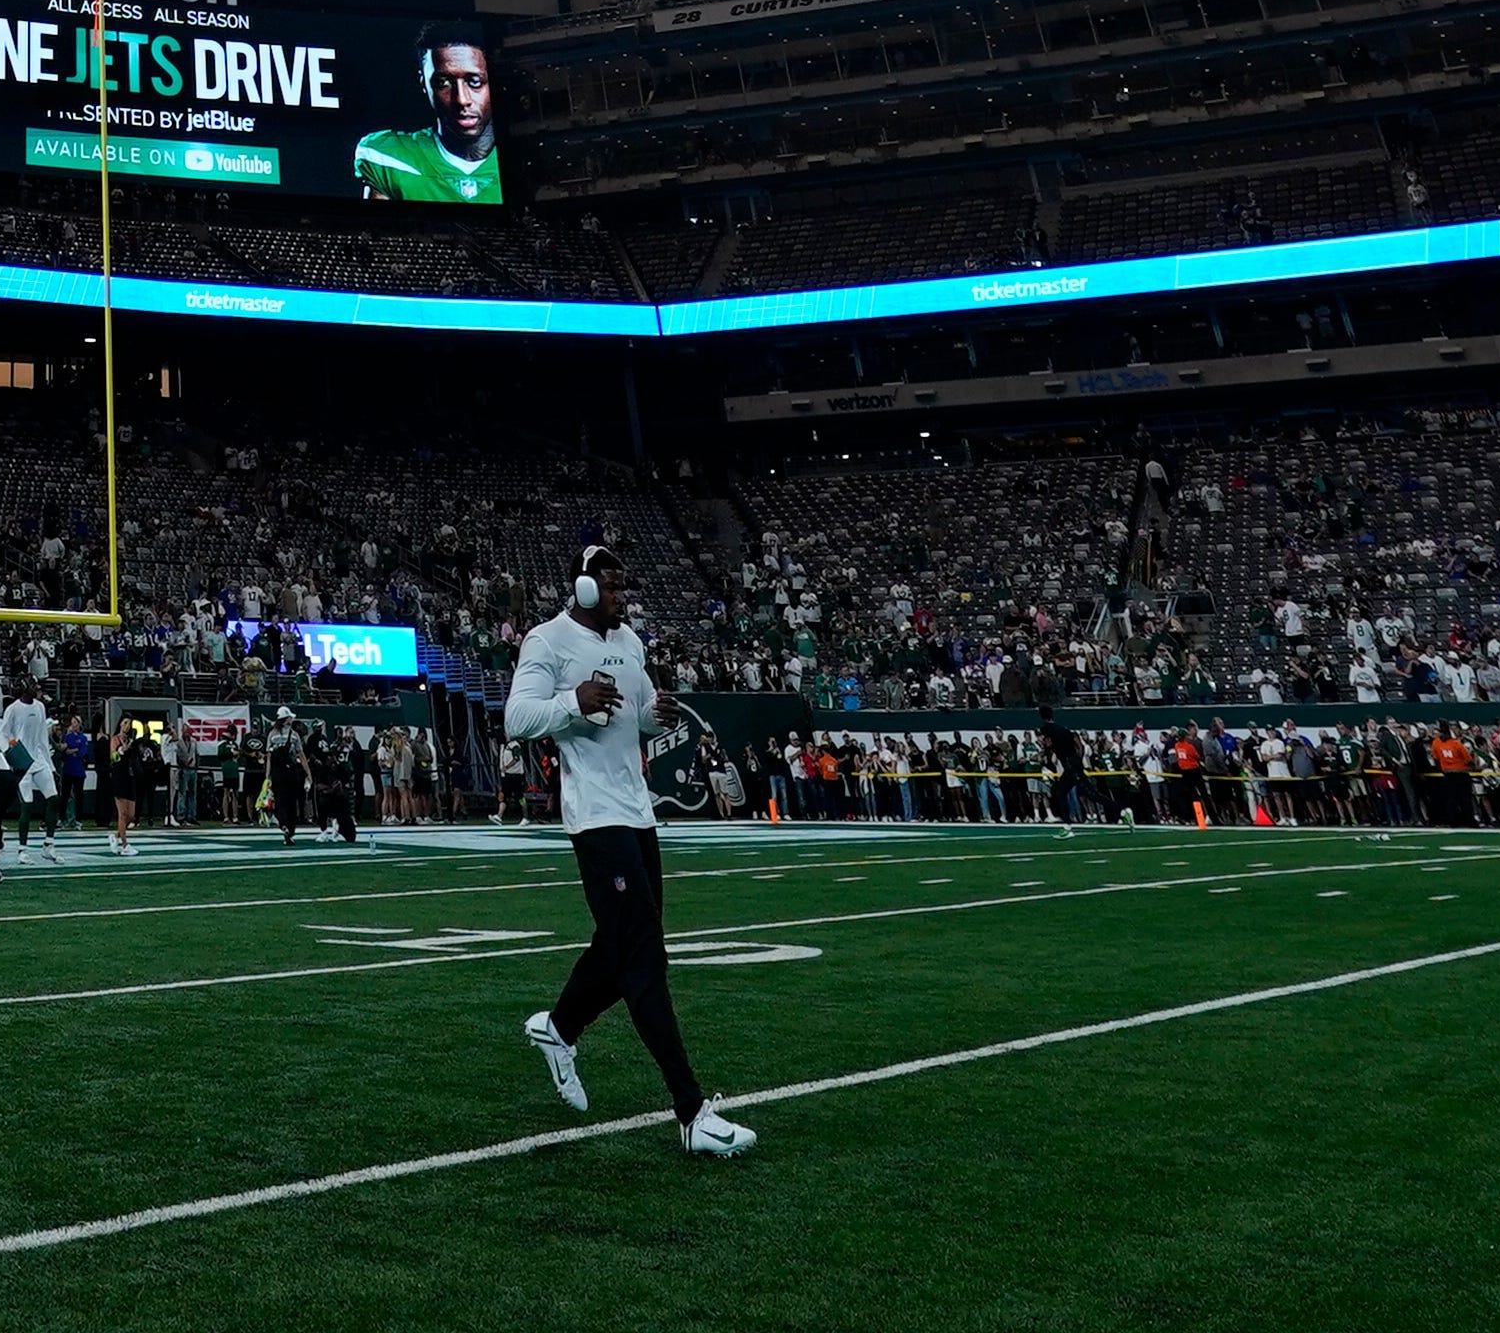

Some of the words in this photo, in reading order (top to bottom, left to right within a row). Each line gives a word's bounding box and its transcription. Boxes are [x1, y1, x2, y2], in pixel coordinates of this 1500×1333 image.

[153, 7, 184, 25] ALL
[186, 9, 250, 31] SEASON
[671, 10, 703, 26] 28
[65, 26, 184, 98] JETS
[193, 38, 340, 110] DRIVE
[160, 111, 186, 129] BY
[186, 107, 255, 132] jetBlue
[34, 138, 141, 165] AVAILABLE
[149, 148, 176, 166] ON
[214, 152, 273, 176] YouTube
[184, 290, 286, 313] ticketmaster
[972, 277, 1088, 302] ticketmaster
[826, 391, 893, 412] verizon
[646, 720, 690, 762] JETS
